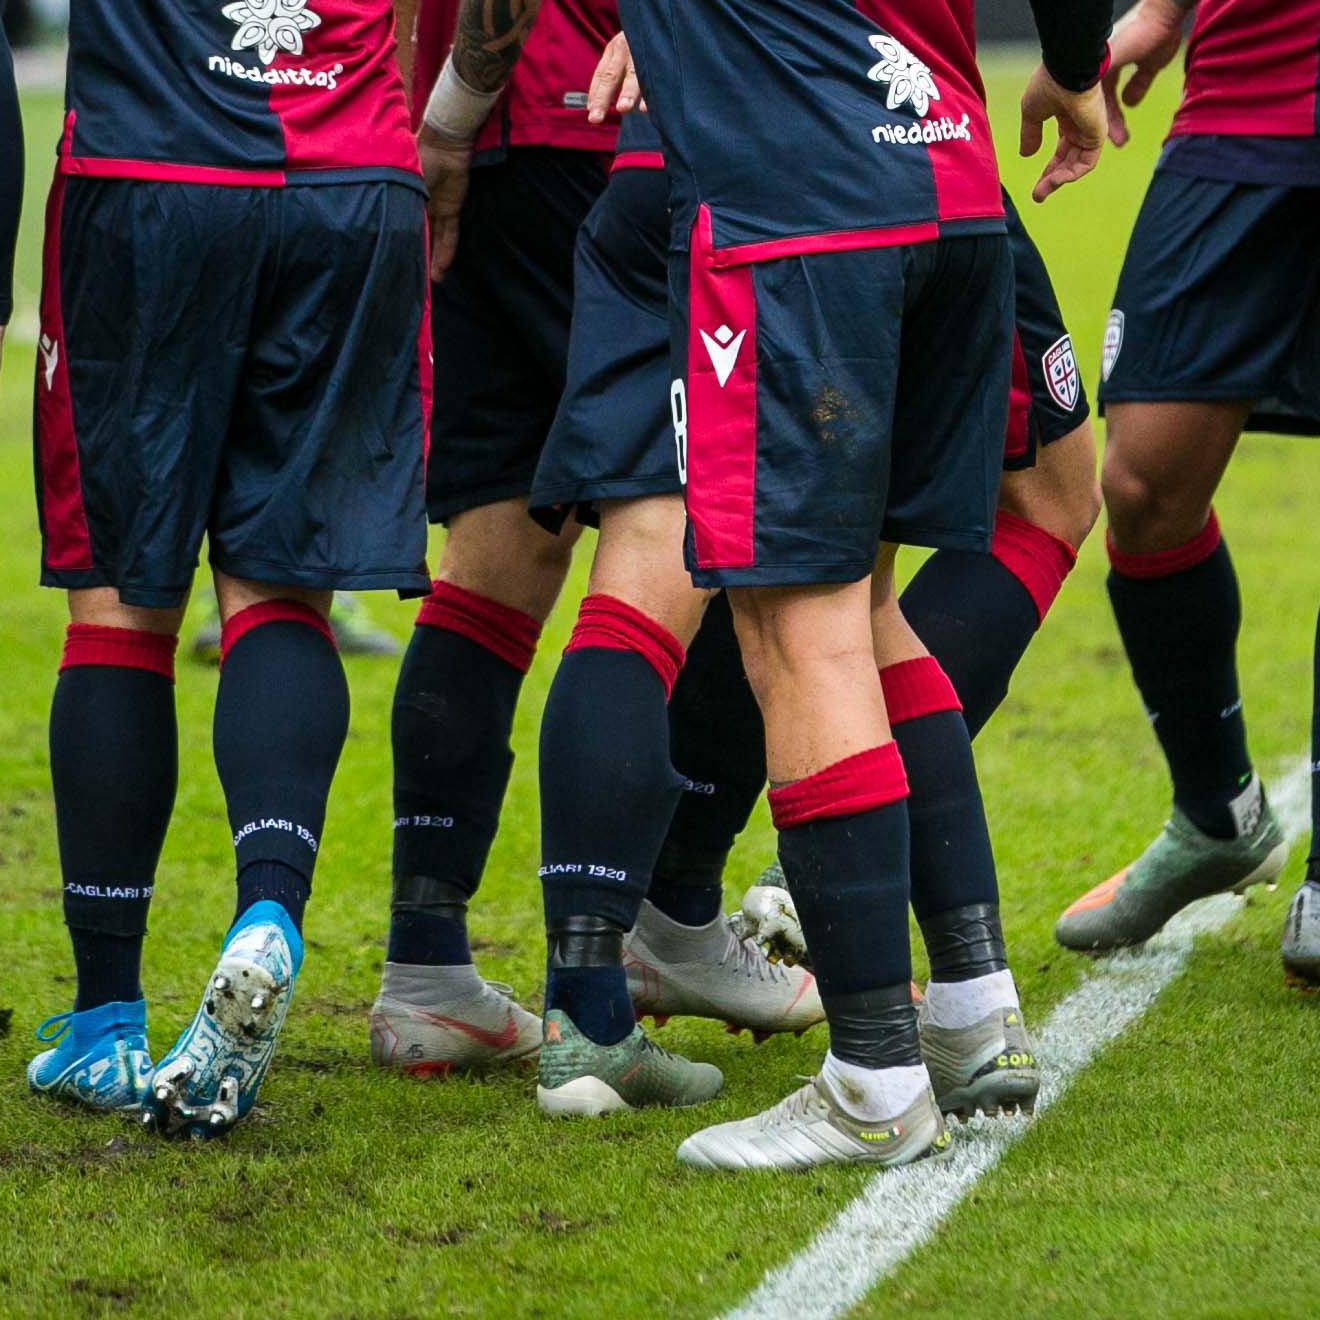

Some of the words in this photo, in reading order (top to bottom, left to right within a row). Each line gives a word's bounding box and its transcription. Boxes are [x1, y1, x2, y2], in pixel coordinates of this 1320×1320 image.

[683, 779, 715, 794] 920
[413, 815, 454, 828] 1920
[587, 864, 627, 881] 1920
